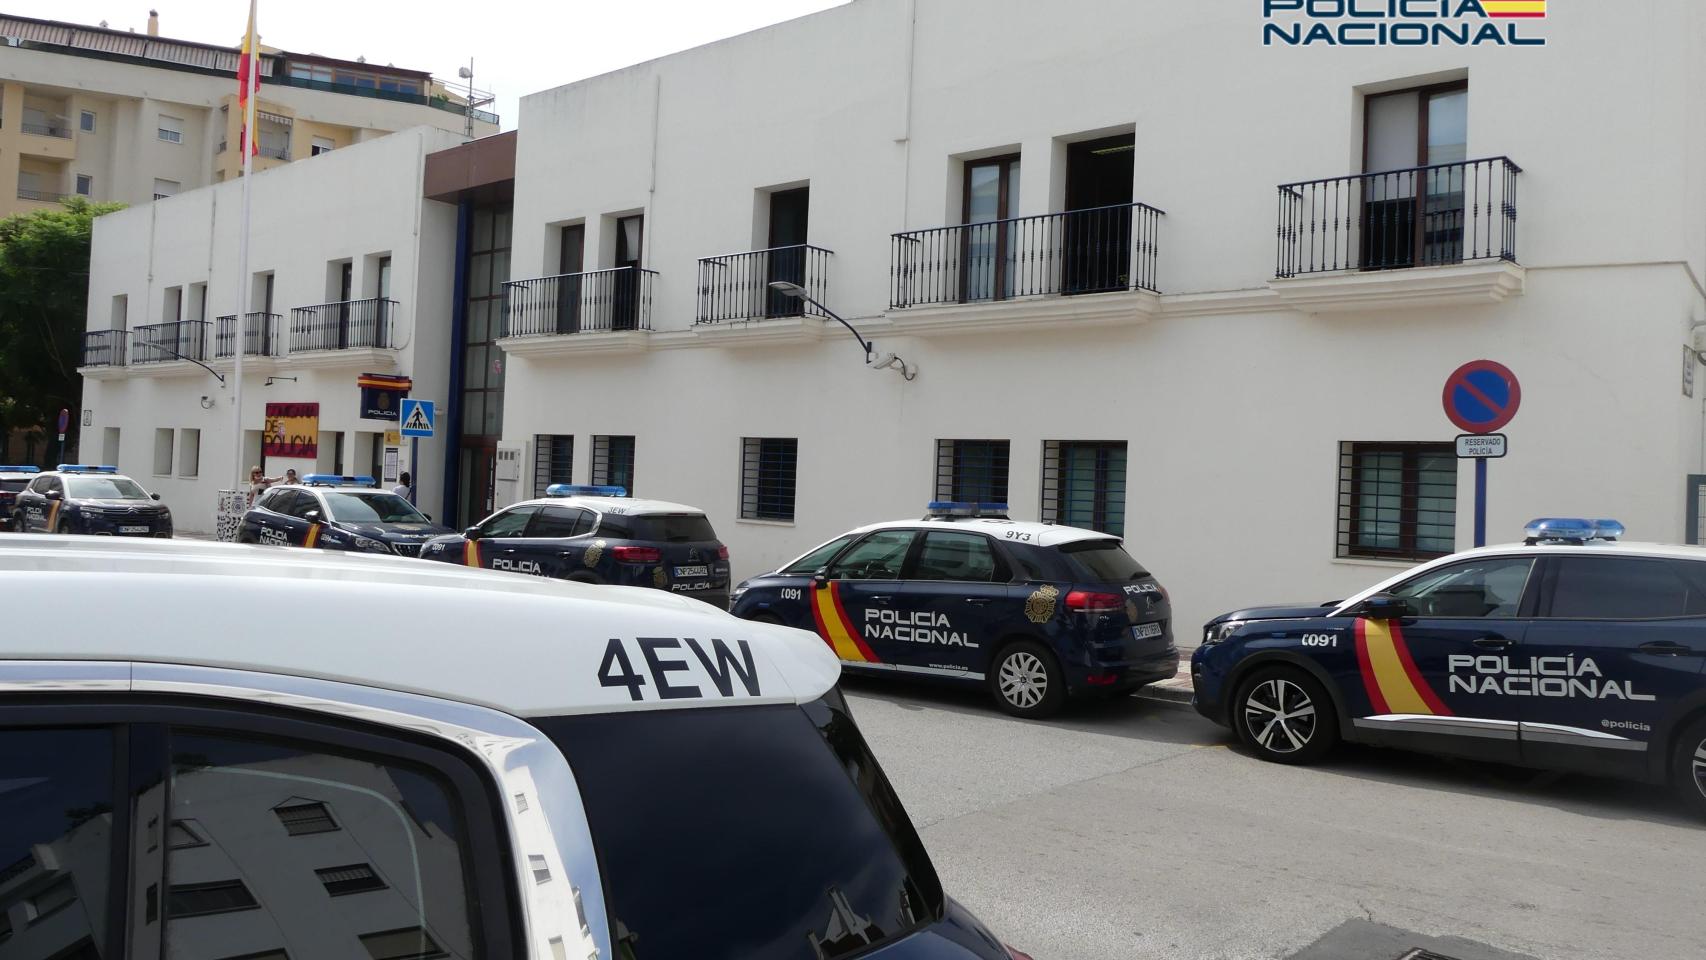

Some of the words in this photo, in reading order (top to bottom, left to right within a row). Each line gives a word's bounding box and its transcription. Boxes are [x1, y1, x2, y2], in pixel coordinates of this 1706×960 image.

[1464, 438, 1501, 446] RESERVADO
[1006, 531, 1031, 541] 9Y3
[493, 558, 541, 573] POLICÍA
[785, 588, 802, 600] 091
[865, 624, 979, 648] NACIONAL
[1308, 633, 1337, 647] 091
[597, 637, 762, 702] 4EW
[1448, 653, 1603, 677] POLICÍA
[1449, 674, 1656, 701] NACIONAL
